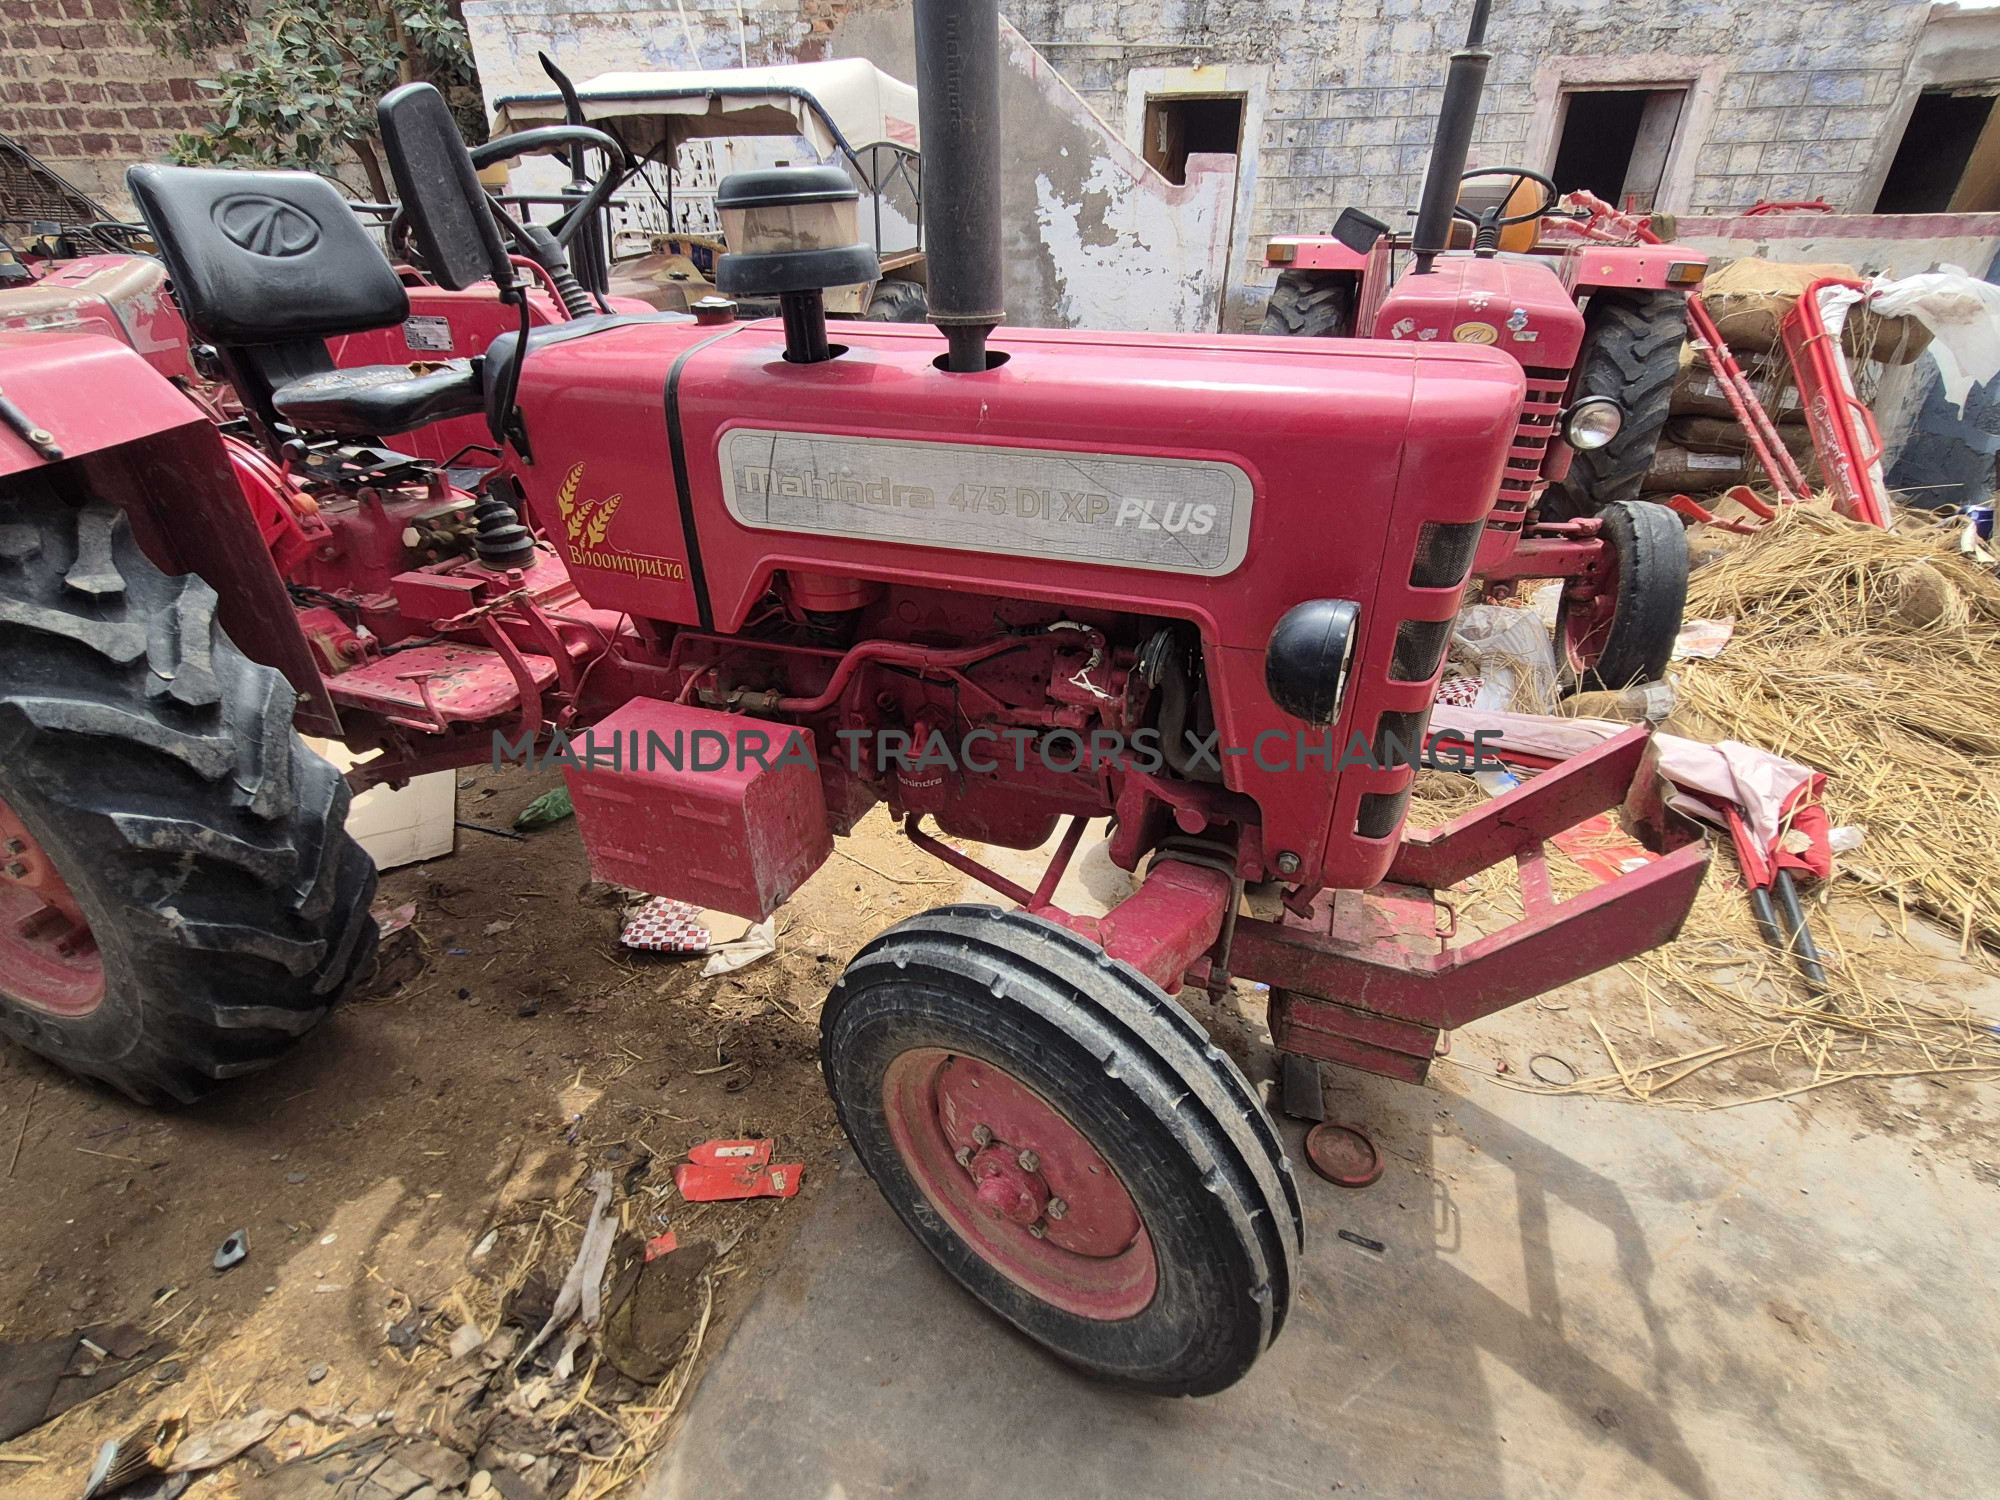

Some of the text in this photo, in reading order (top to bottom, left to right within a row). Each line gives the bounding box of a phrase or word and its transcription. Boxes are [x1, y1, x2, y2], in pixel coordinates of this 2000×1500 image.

[947, 483, 1007, 516] 475
[1015, 488, 1051, 520] DI
[1059, 491, 1110, 524] XP
[1114, 497, 1217, 535] PLUS
[568, 544, 685, 580] Bhoomiputra
